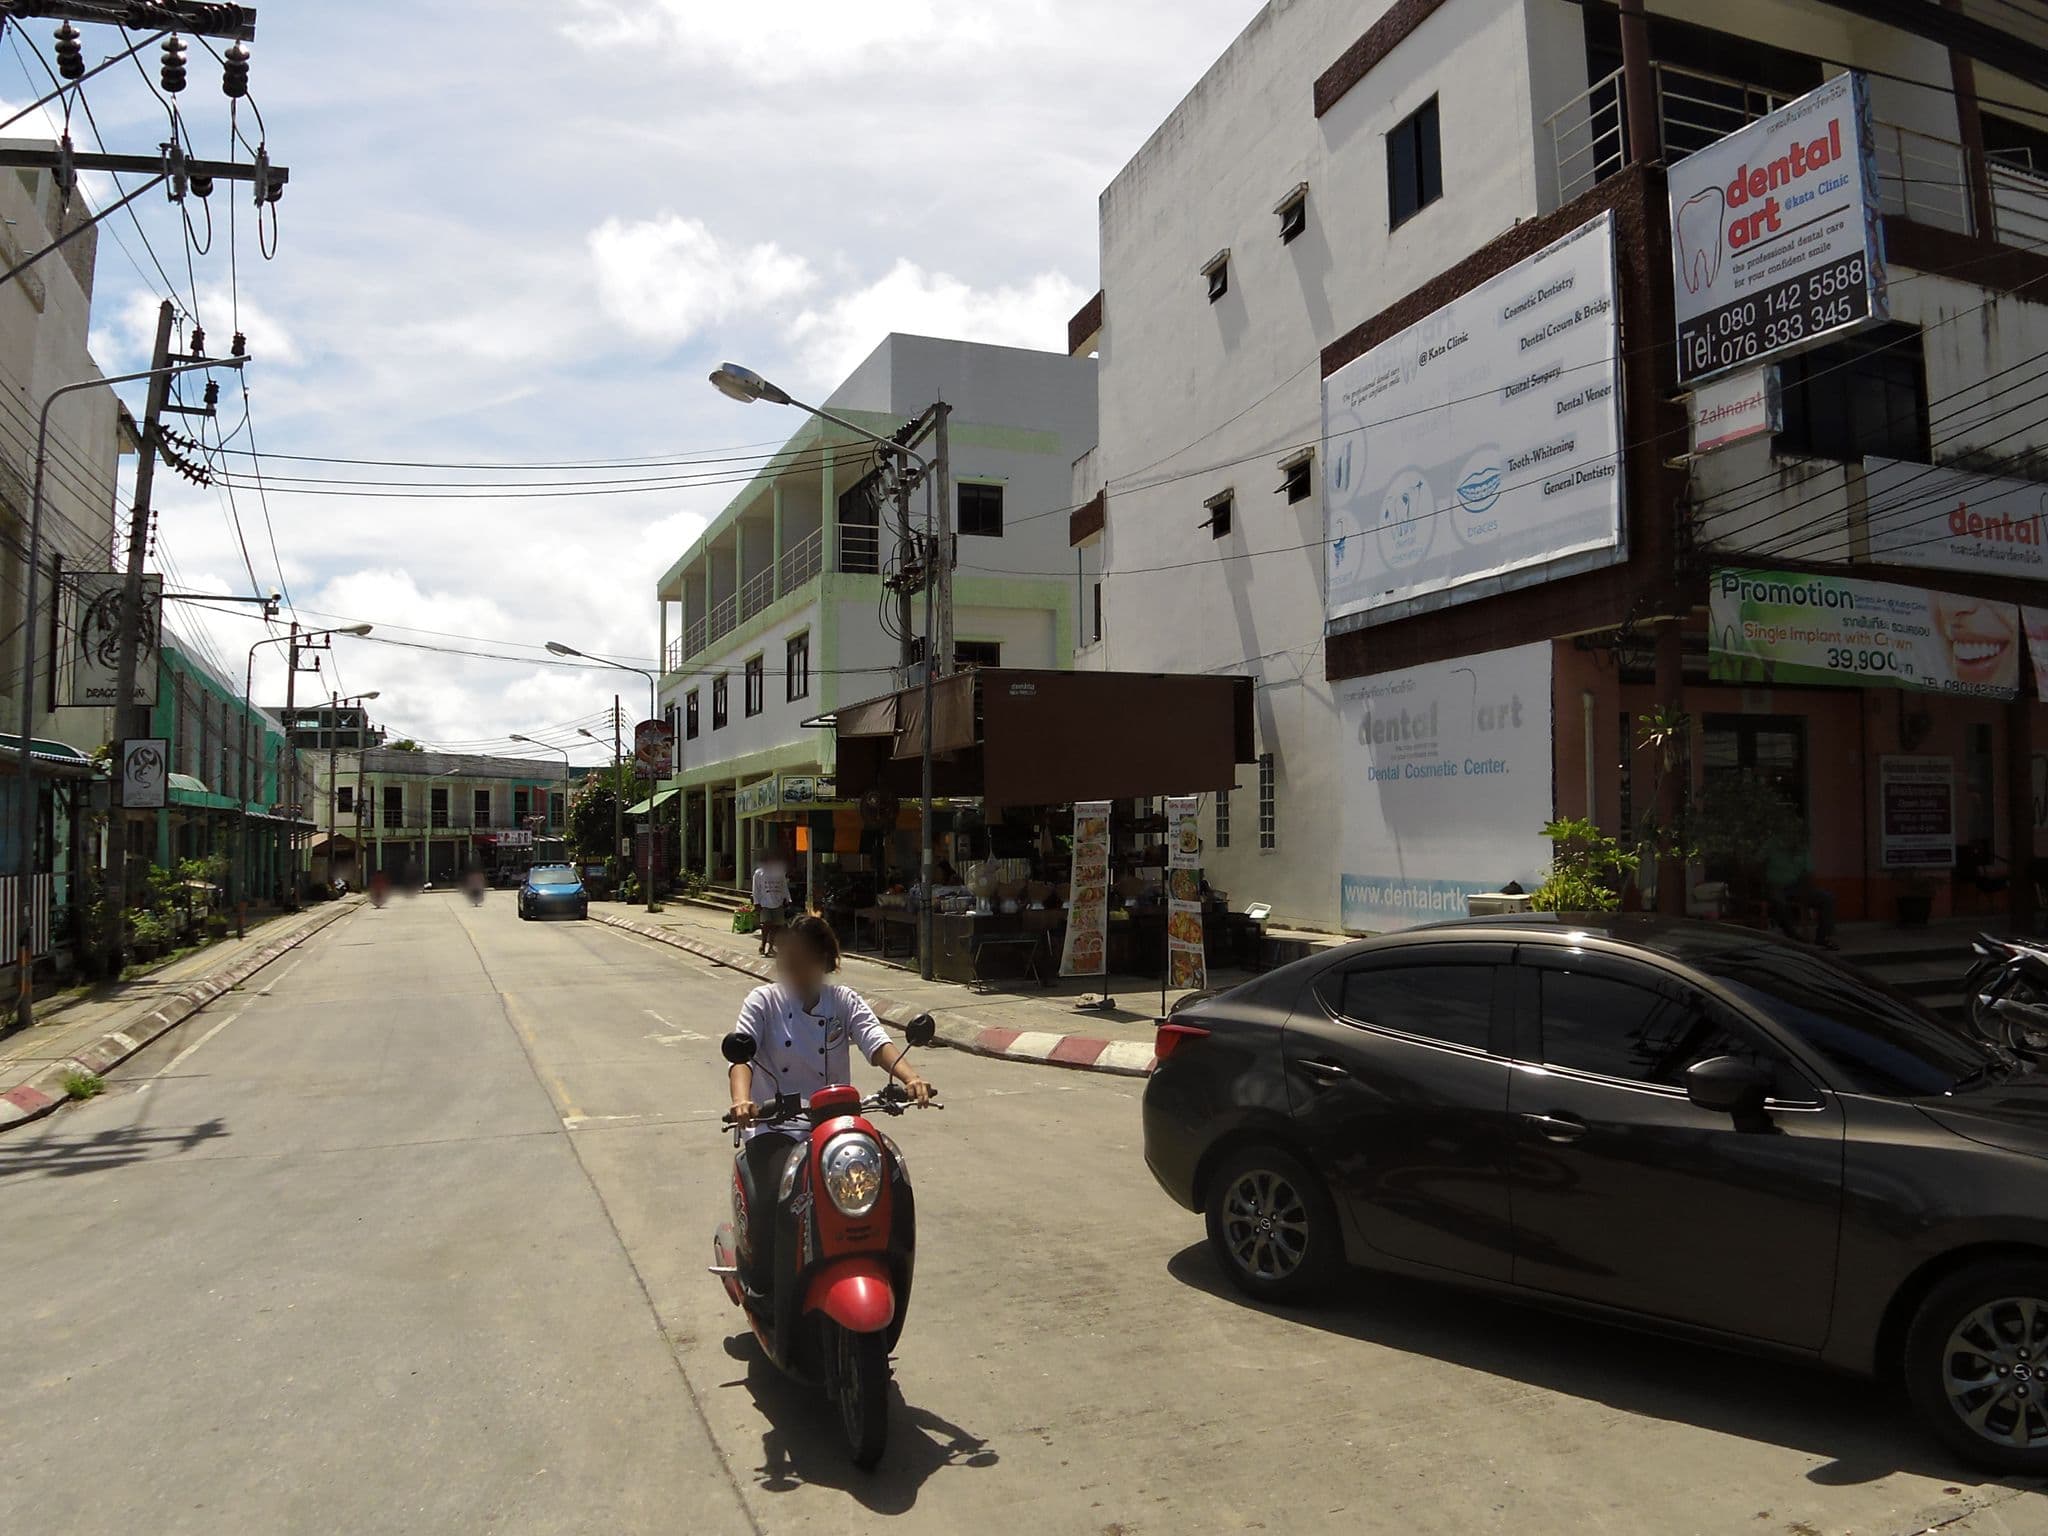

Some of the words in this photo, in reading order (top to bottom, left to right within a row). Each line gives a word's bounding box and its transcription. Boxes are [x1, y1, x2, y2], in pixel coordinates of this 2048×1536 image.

[1726, 119, 1841, 208] dental
[1818, 174, 1850, 196] Clinic
[1728, 197, 1781, 248] art
[1732, 262, 1745, 274] the
[1746, 241, 1796, 273] professional
[1797, 228, 1825, 250] dental
[1826, 222, 1845, 236] care
[1734, 277, 1746, 289] for
[1747, 270, 1766, 287] your
[1767, 251, 1806, 279] confident
[1808, 241, 1832, 260] smile
[1504, 292, 1537, 320] Cosmetic
[1537, 275, 1575, 303] Dentistry
[1719, 301, 1756, 336] 080
[1764, 283, 1801, 317] 142
[1808, 259, 1863, 300] 5588
[1446, 331, 1469, 351] Clinic
[1520, 325, 1545, 351] Dental
[1574, 310, 1583, 324] &
[1720, 332, 1757, 366] 076
[1764, 316, 1804, 350] 333
[1811, 295, 1852, 330] 345
[1505, 379, 1530, 398] Dental
[1556, 394, 1582, 415] Dental
[1583, 383, 1612, 407] Veneer
[1699, 391, 1762, 426] Zahnarzt
[1507, 437, 1575, 473] Tooth-Whitening
[1543, 472, 1575, 496] General
[1575, 462, 1617, 487] Dentistry
[1948, 502, 2041, 545] dental
[1722, 573, 1854, 610] Promotion
[1744, 624, 1787, 643] Single
[1790, 627, 1841, 645] Implant
[1844, 631, 1872, 645] with
[1358, 701, 1438, 746] dental
[1477, 695, 1523, 732] art
[1367, 763, 1400, 782] Dental
[1404, 760, 1458, 780] Cosmetic
[1344, 883, 1468, 913] www.dentalartk
